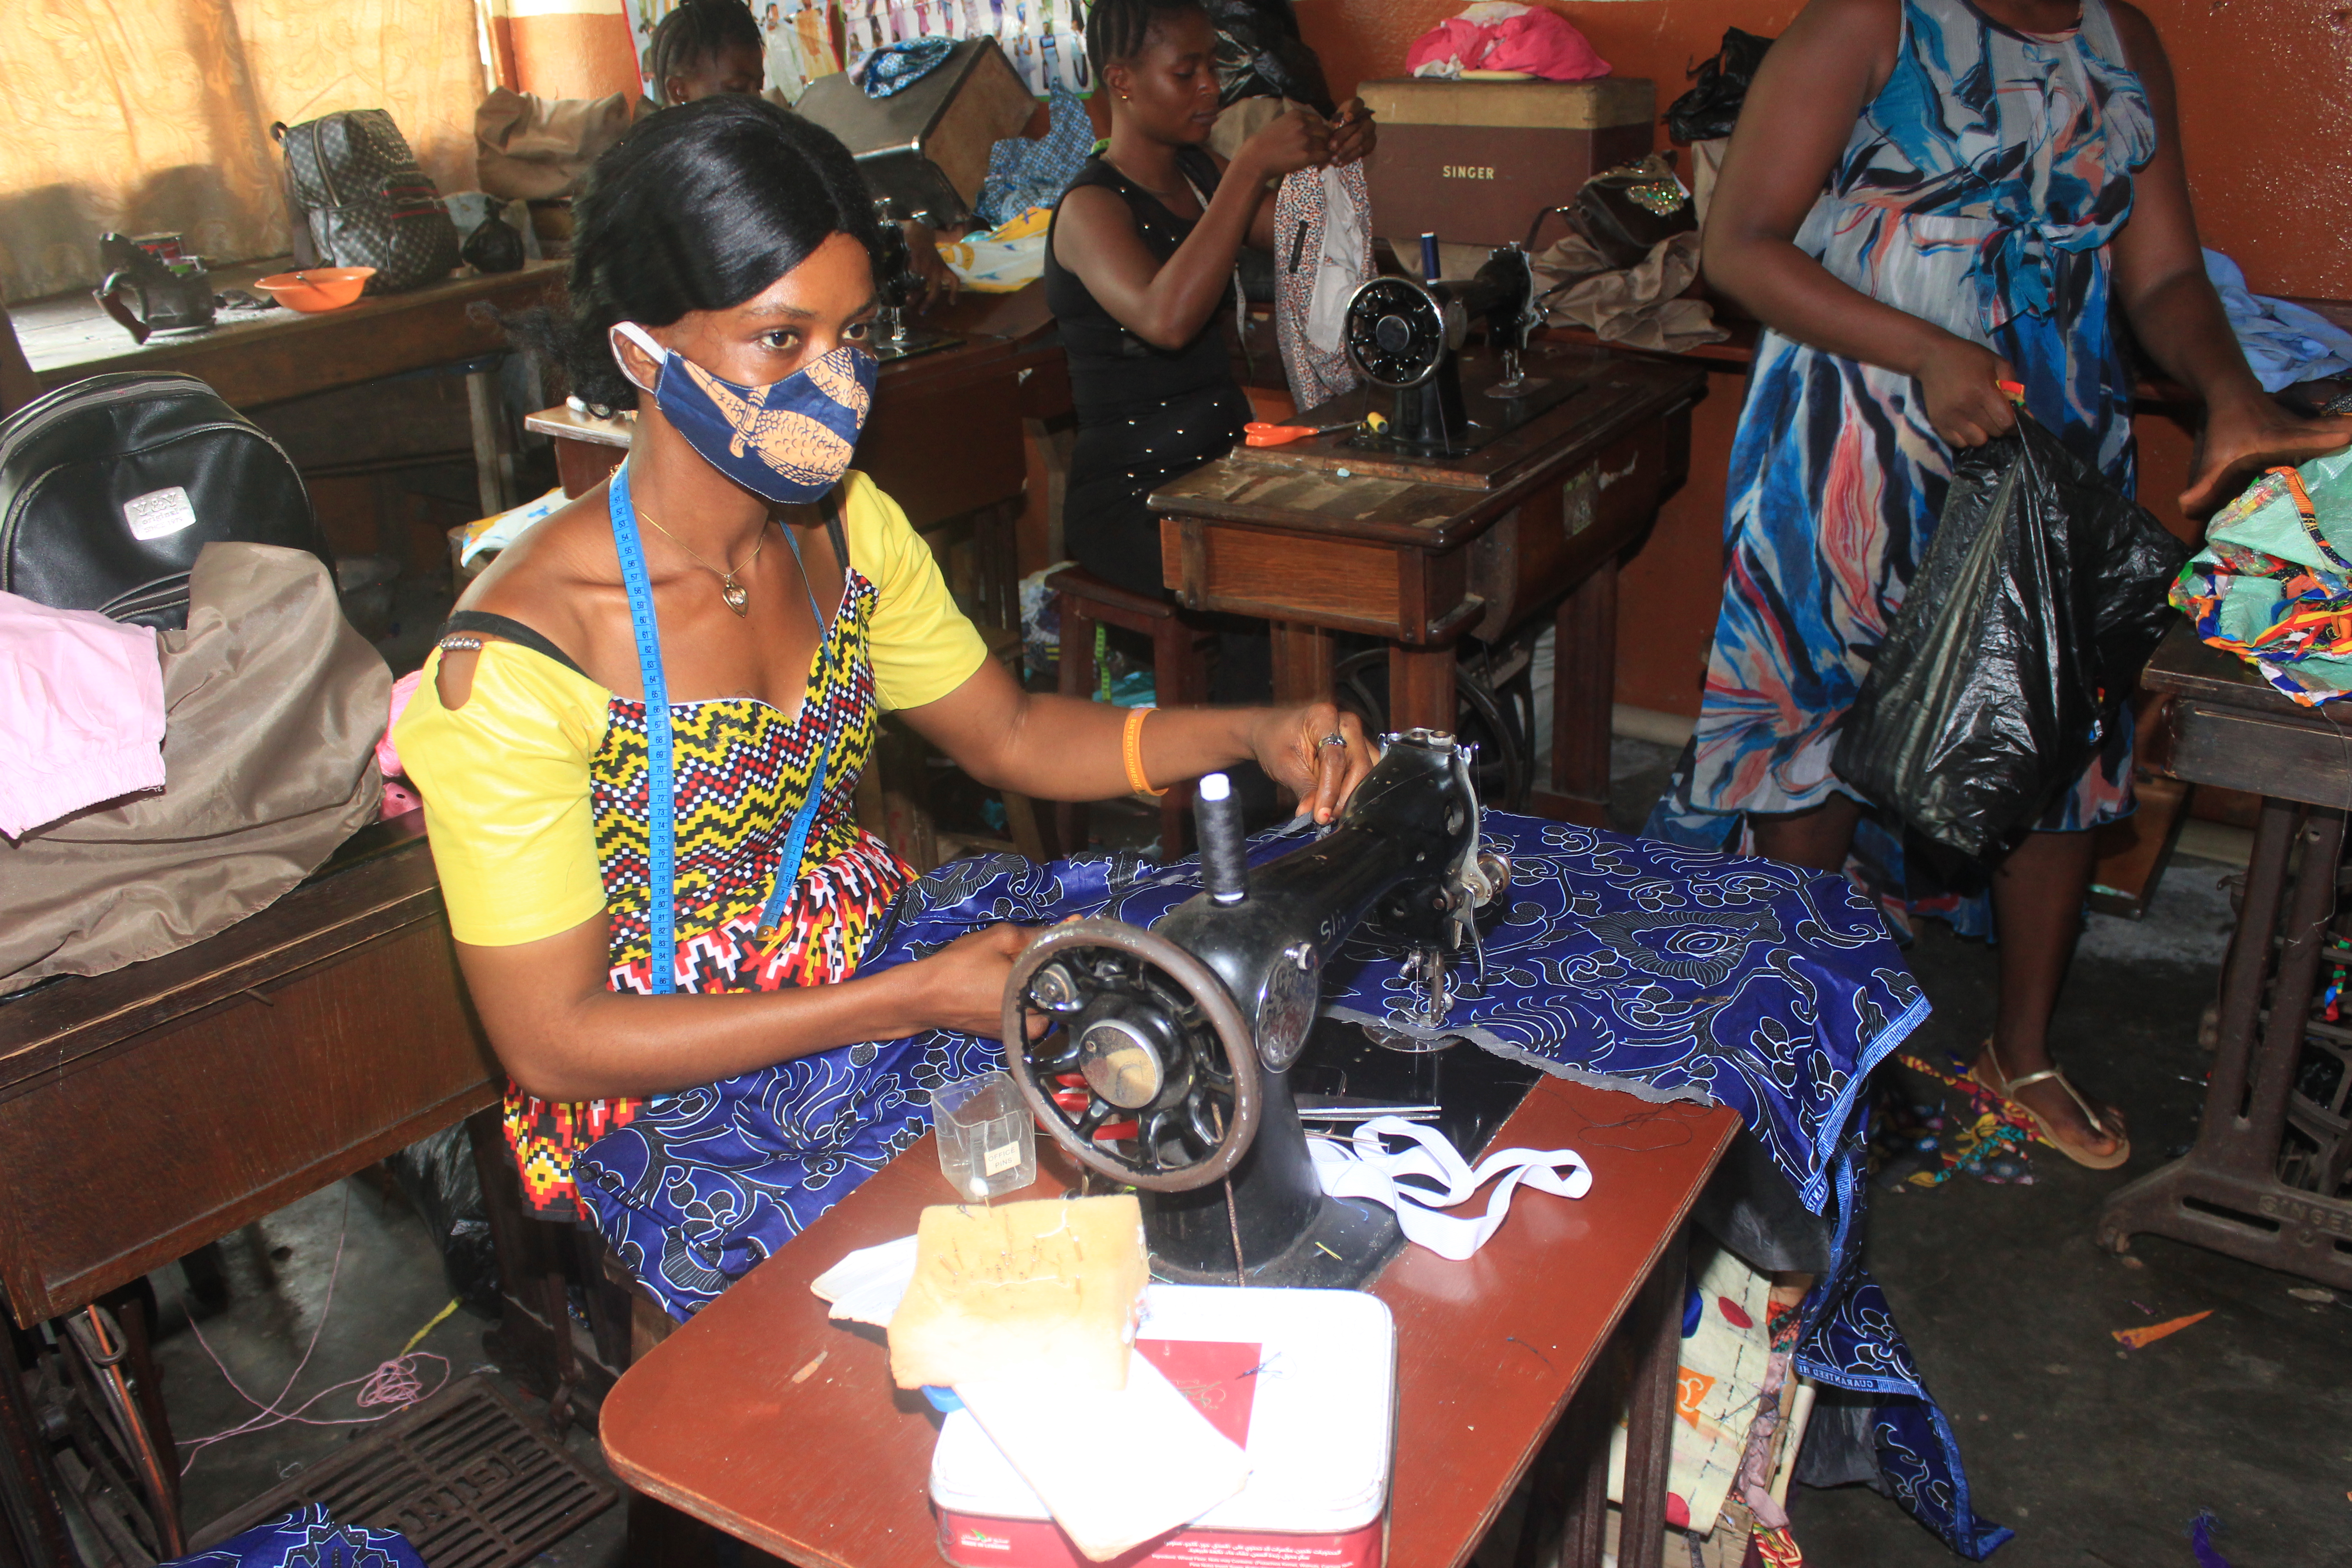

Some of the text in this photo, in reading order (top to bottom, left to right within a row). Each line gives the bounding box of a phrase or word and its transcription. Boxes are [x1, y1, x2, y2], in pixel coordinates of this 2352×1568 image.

[1443, 165, 1494, 180] SINGER
[1127, 719, 1142, 788] ENTERTAINMENT
[988, 1147, 1016, 1162] OFFICE
[995, 1157, 1013, 1168] PINS
[2256, 1195, 2352, 1235] SINGE
